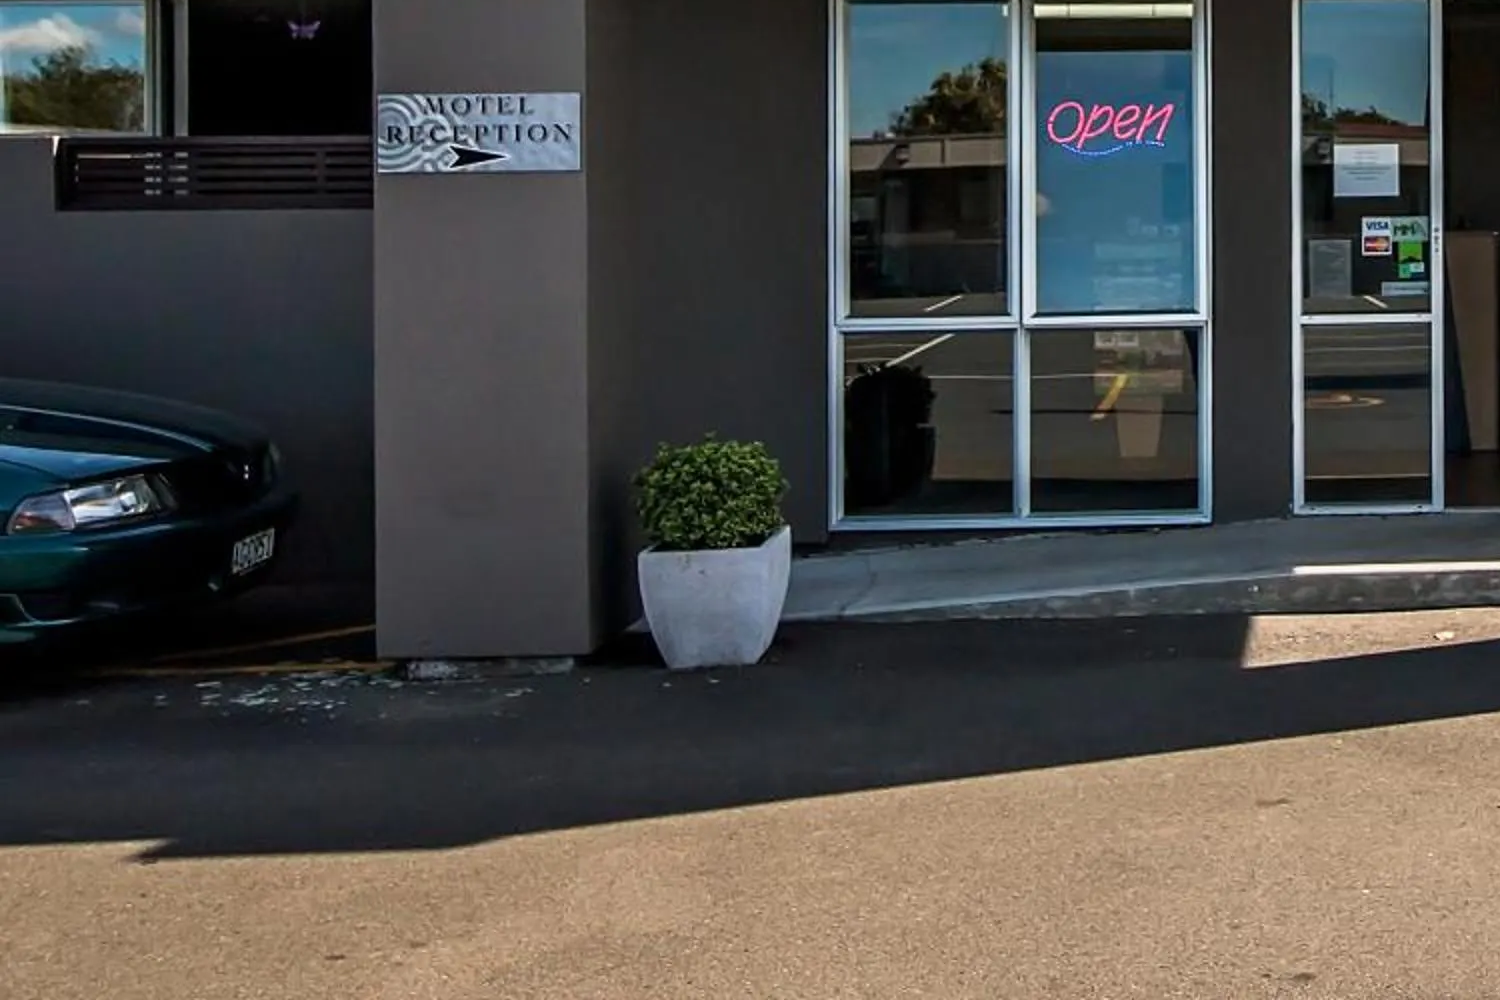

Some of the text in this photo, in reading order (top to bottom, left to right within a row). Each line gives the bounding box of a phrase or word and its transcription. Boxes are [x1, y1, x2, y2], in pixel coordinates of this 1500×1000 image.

[422, 96, 535, 116] MOTEL
[386, 122, 574, 145] RECEPTION
[1046, 101, 1174, 149] Open
[1365, 221, 1390, 231] VISA
